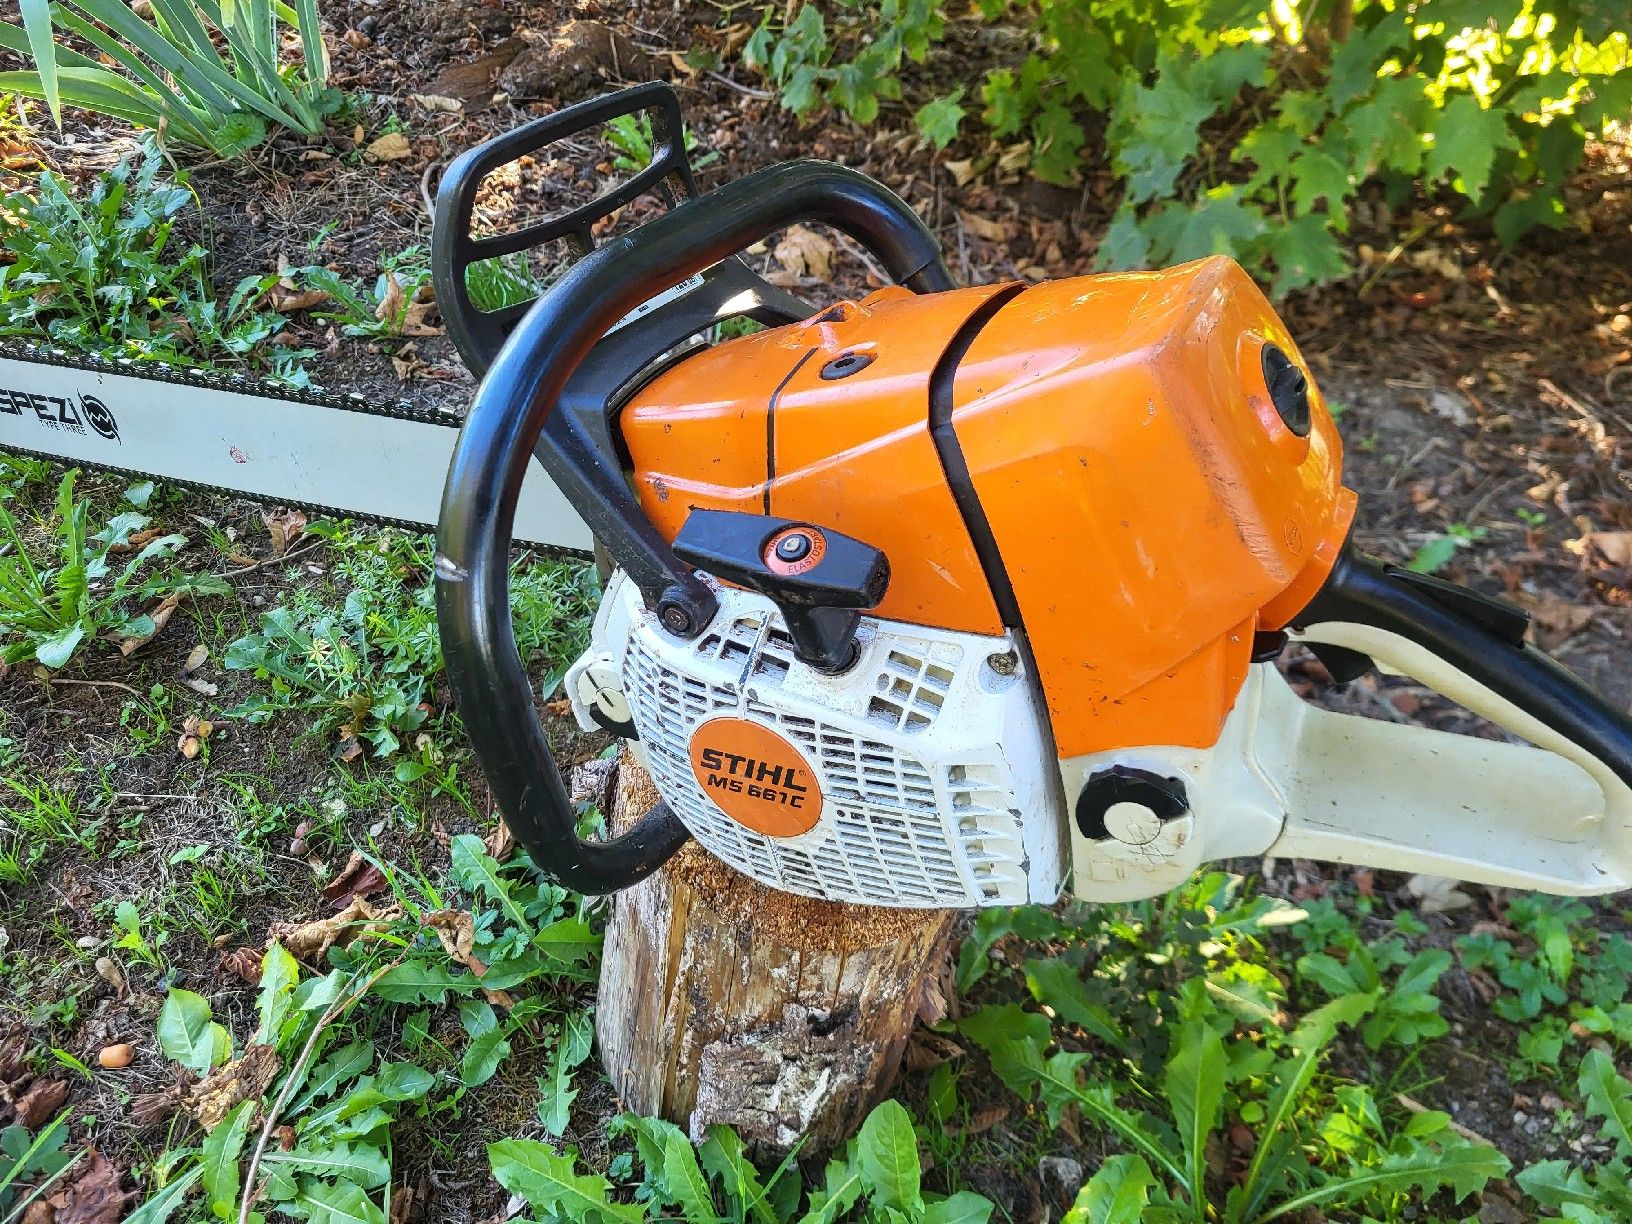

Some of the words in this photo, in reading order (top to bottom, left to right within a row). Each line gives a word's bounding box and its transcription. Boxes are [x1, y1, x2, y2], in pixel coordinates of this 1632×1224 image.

[60, 422, 88, 436] THREE
[700, 747, 807, 793] STIHL
[707, 773, 743, 793] MS
[747, 783, 805, 809] 661C
